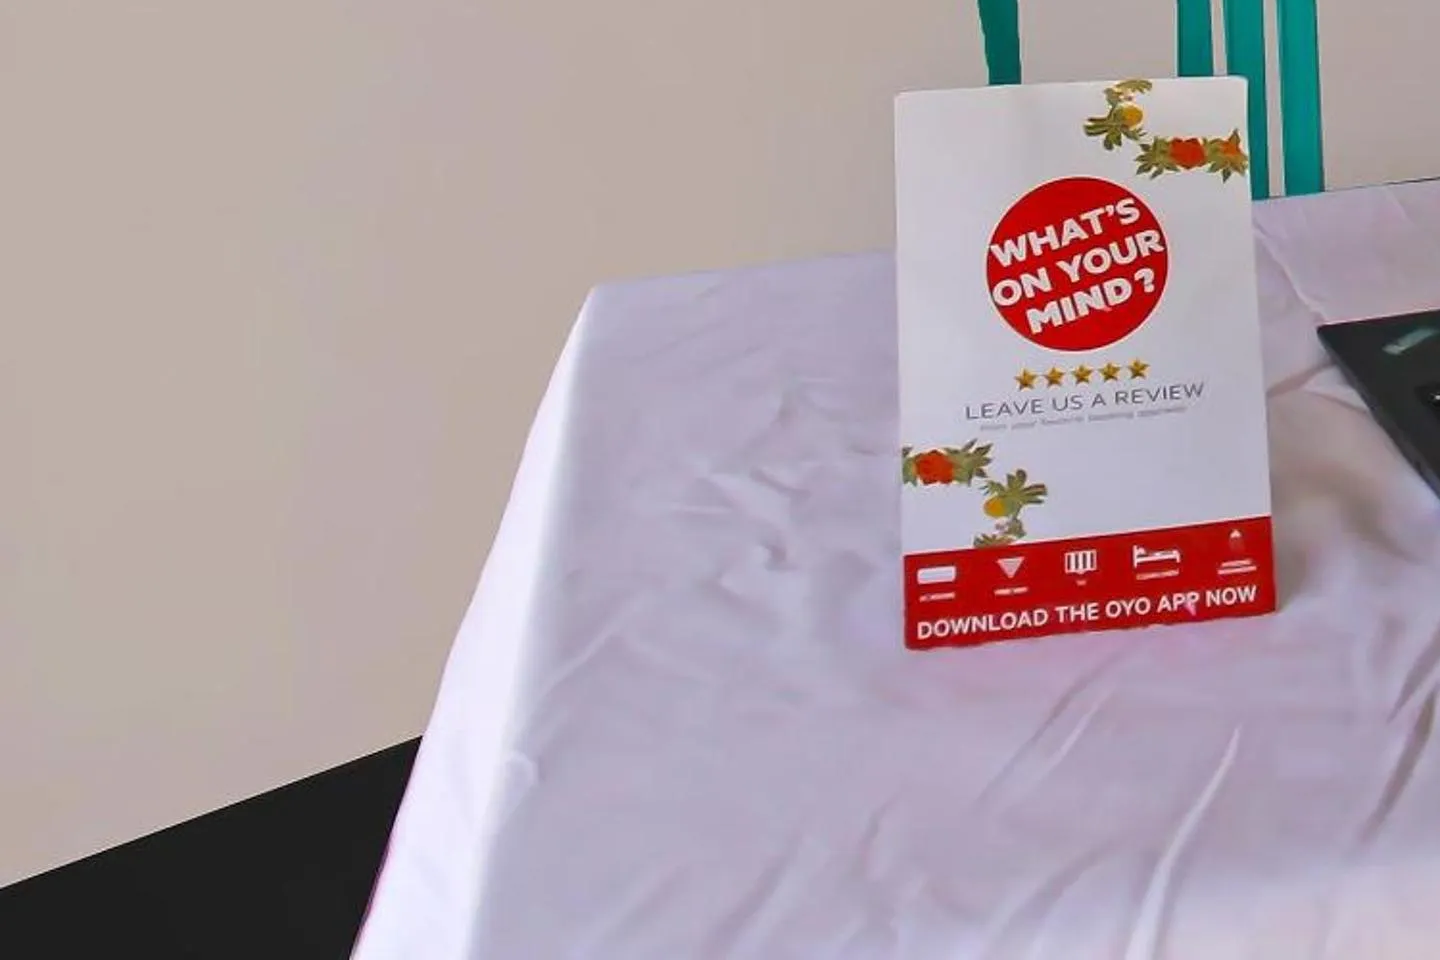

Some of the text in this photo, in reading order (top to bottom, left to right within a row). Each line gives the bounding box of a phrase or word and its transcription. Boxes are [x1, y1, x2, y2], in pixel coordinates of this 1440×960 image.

[993, 229, 1164, 306] ON YOUR
[965, 398, 1045, 421] LEAVE
[1051, 394, 1084, 412] US
[1090, 393, 1107, 408] A
[1114, 381, 1206, 406] REVIEW
[916, 584, 1257, 640] DOWNLOAD THE OYO APP NOW
